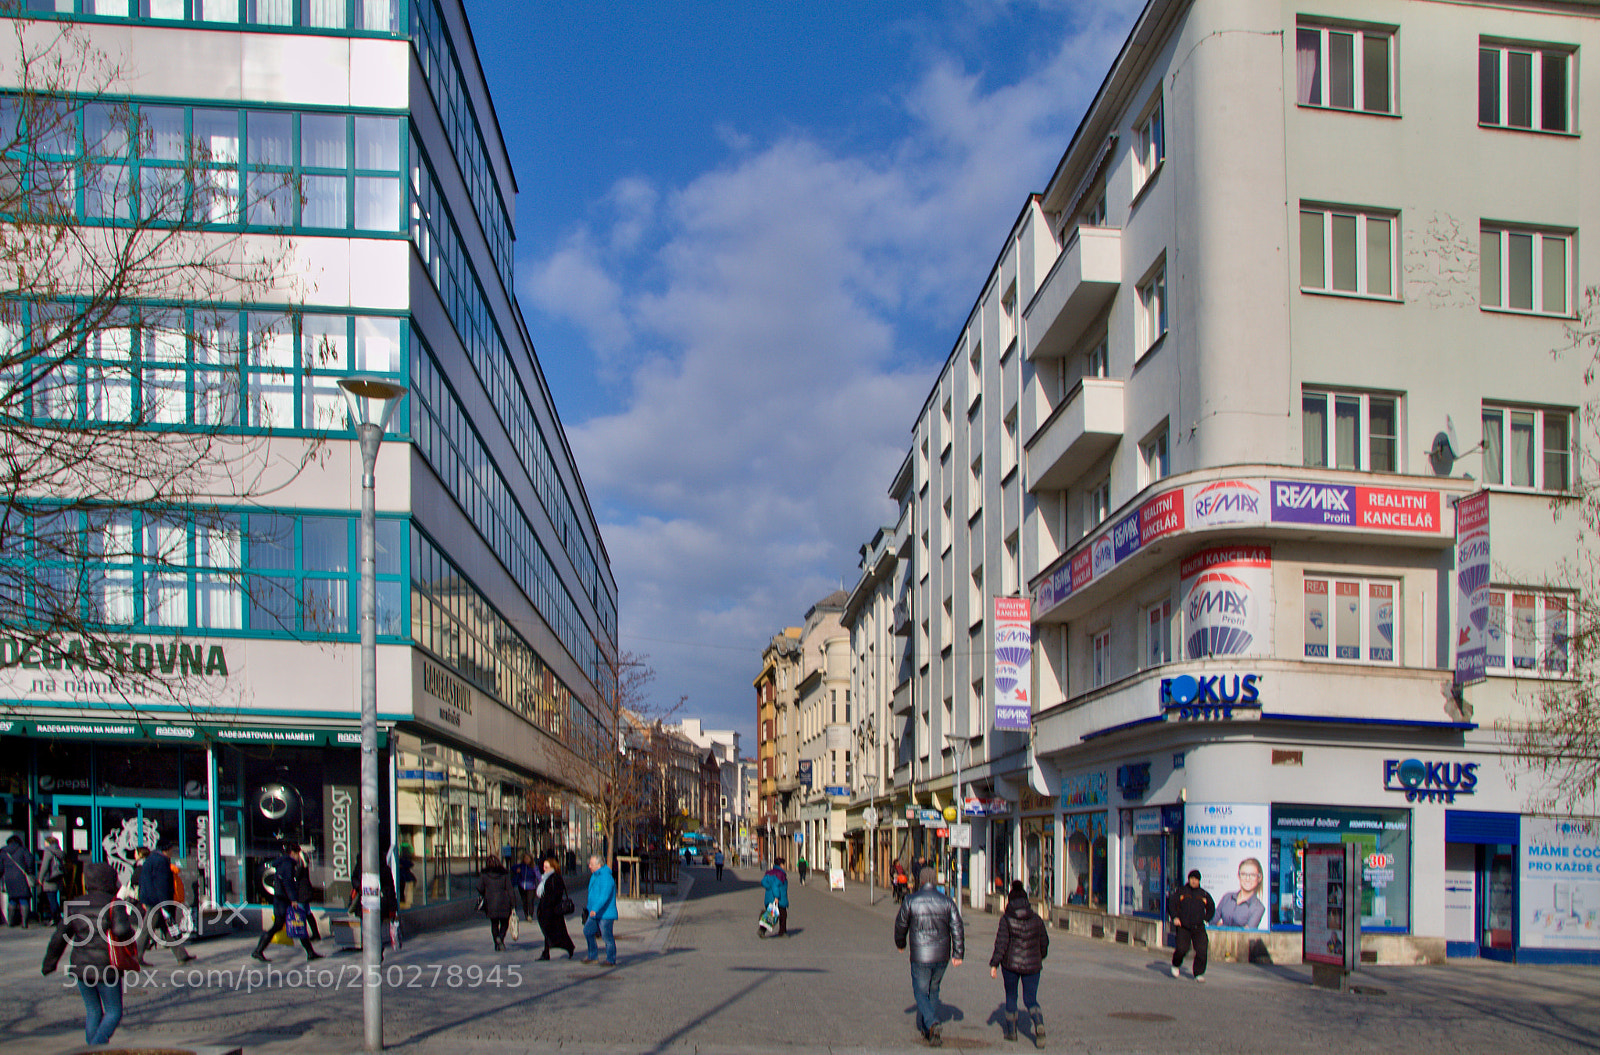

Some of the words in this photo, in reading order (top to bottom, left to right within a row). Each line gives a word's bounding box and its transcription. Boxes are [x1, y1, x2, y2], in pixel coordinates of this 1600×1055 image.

[1195, 493, 1258, 519] RE/MAX
[1276, 485, 1350, 511] RE/MAX
[1369, 493, 1427, 509] REALITNÍ
[1144, 495, 1173, 522] REALITNÍ
[1323, 512, 1350, 523] Profit
[1363, 511, 1433, 528] KANCELÁŘ
[1142, 512, 1178, 541] KANCELÁŘ
[1206, 550, 1267, 566] KANCELÁŘ
[1458, 540, 1489, 564] RE/MA
[1306, 581, 1326, 593] REA
[1343, 583, 1352, 595] LI
[1189, 590, 1248, 624] RE/MAX
[1222, 614, 1246, 626] Profit
[1307, 645, 1327, 657] KAN
[33, 679, 57, 693] na
[1160, 674, 1261, 705] FOKUS
[1180, 707, 1233, 719] OPTIK
[37, 725, 93, 734] RADEGASTOVNA
[94, 726, 104, 734] NA
[104, 725, 135, 735] NÁMĚSTÍ
[218, 730, 273, 740] RADEGASTOVNA
[274, 732, 284, 740] NA
[285, 731, 315, 741] NÁMĚSTÍ
[1384, 758, 1479, 790] FOKUS
[57, 778, 89, 789] pepsi
[1405, 790, 1456, 803] OPTIK
[1204, 806, 1233, 815] FOKUS
[331, 785, 352, 881] RADEGAST
[1187, 823, 1217, 836] MÁME
[1220, 823, 1262, 836] BRÝLE
[1187, 839, 1202, 848] PRO
[1203, 837, 1236, 848] KAŽDÉ
[1528, 843, 1570, 857] MÁME
[1369, 853, 1387, 869] 30
[1528, 861, 1553, 872] PRO
[1555, 860, 1593, 874] KAŽDÉ
